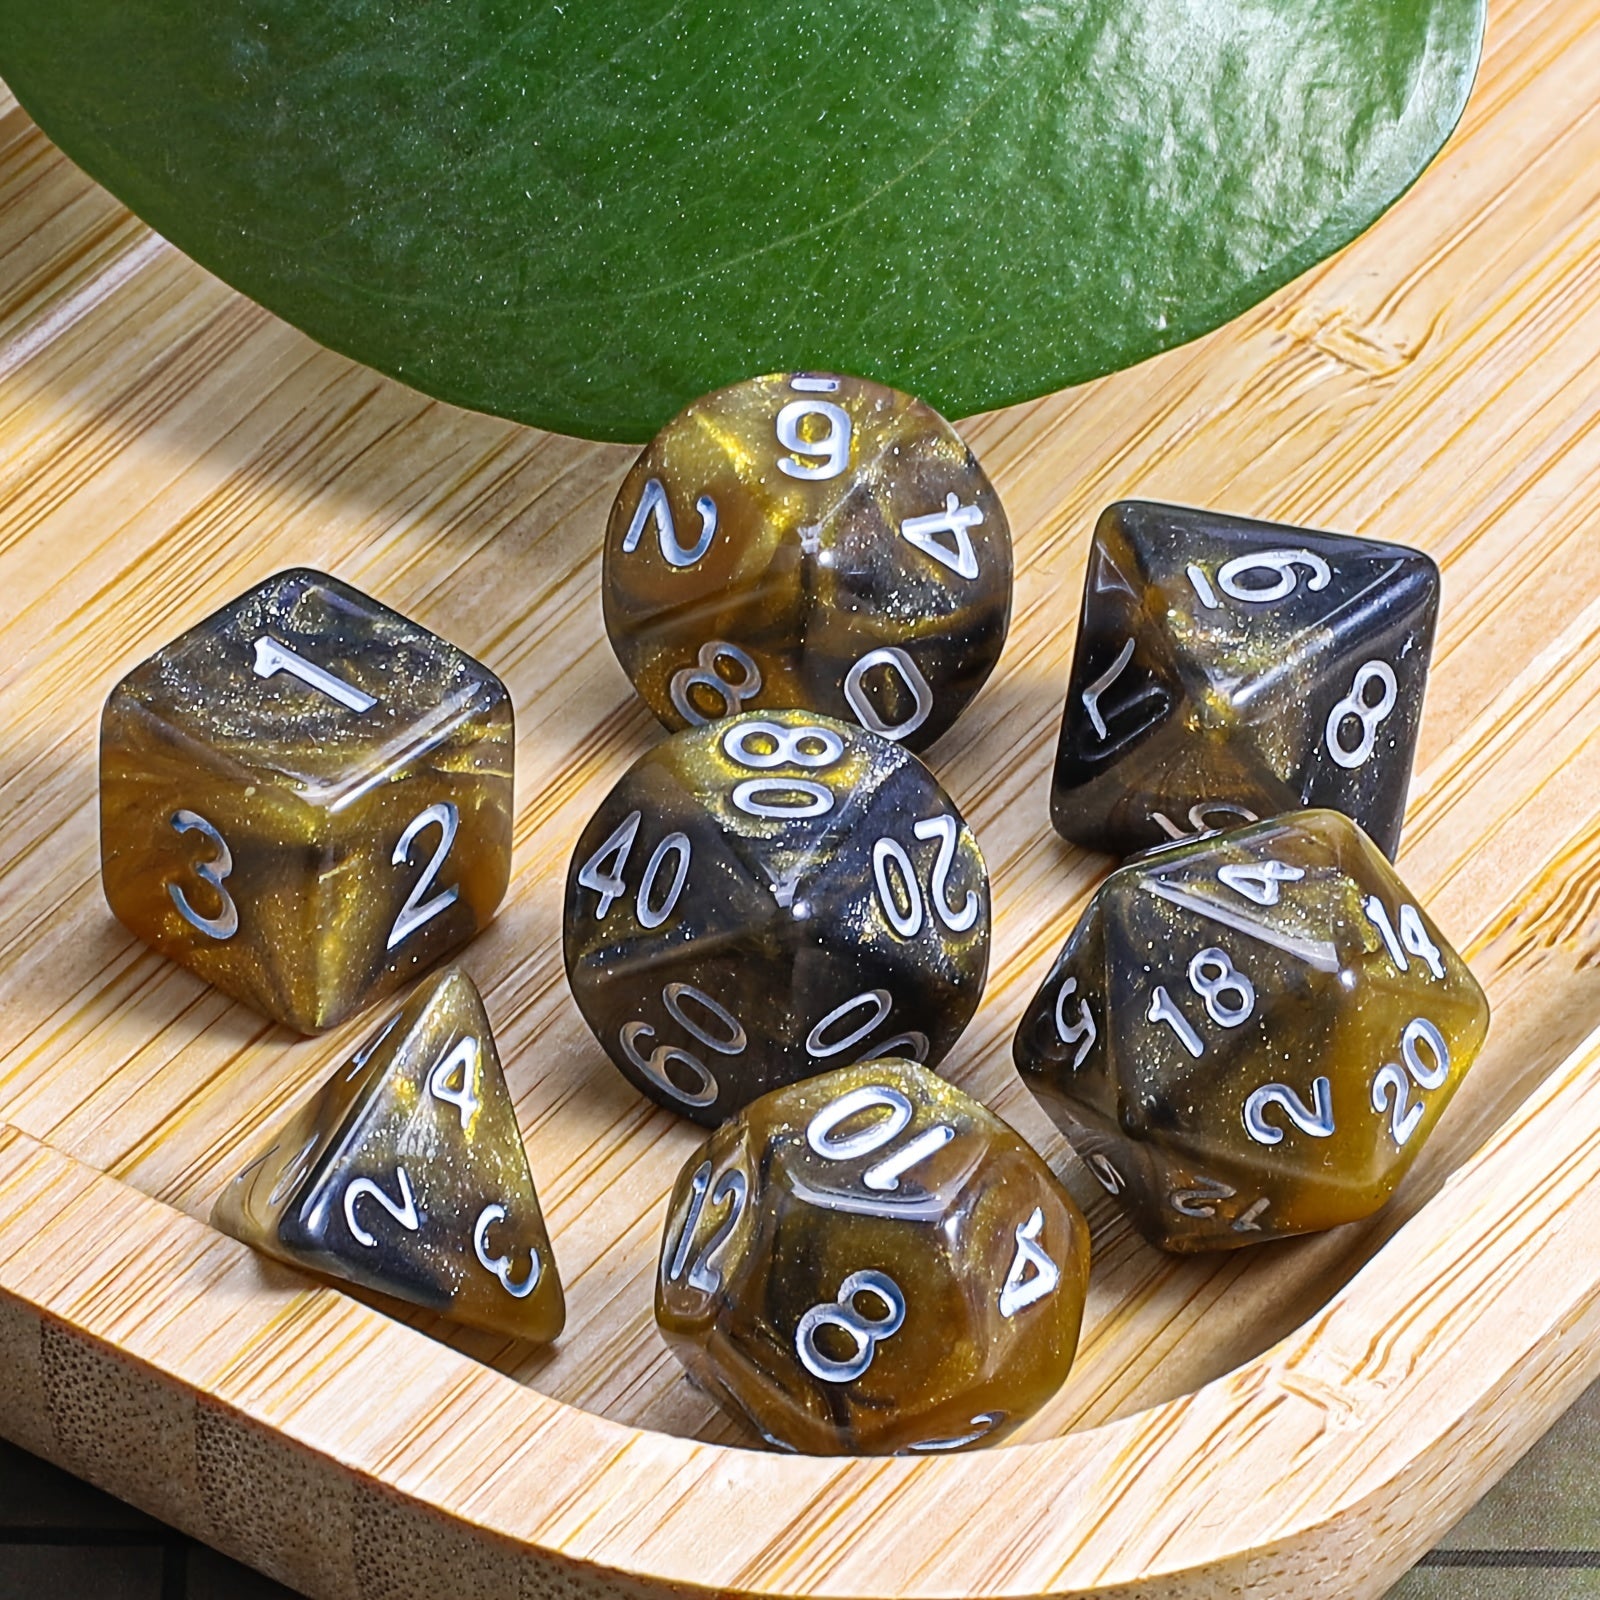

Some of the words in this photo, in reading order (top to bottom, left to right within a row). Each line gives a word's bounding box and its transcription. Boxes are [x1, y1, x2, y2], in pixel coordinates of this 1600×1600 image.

[622, 479, 718, 568] 2
[901, 492, 984, 579] 4
[253, 636, 378, 713] 1
[670, 641, 762, 727] 8
[844, 647, 933, 740] 0
[1326, 660, 1398, 768] 8
[723, 721, 845, 818] 80
[170, 809, 239, 940] 3
[387, 802, 459, 950] 2
[578, 810, 691, 928] 40
[873, 814, 979, 937] 20
[1217, 860, 1305, 906] 4
[1363, 896, 1445, 979] 14
[619, 982, 748, 1107] 60
[1055, 976, 1097, 1071] 5
[1146, 947, 1255, 1058] 18
[430, 1036, 478, 1130] 4
[1244, 1076, 1335, 1144] 2
[1372, 1017, 1450, 1145] 20
[806, 1085, 956, 1191] 10
[344, 1166, 420, 1246] 2
[474, 1203, 541, 1298] 3
[669, 1160, 748, 1294] 12
[999, 1207, 1060, 1318] 4
[796, 1269, 906, 1383] 8
